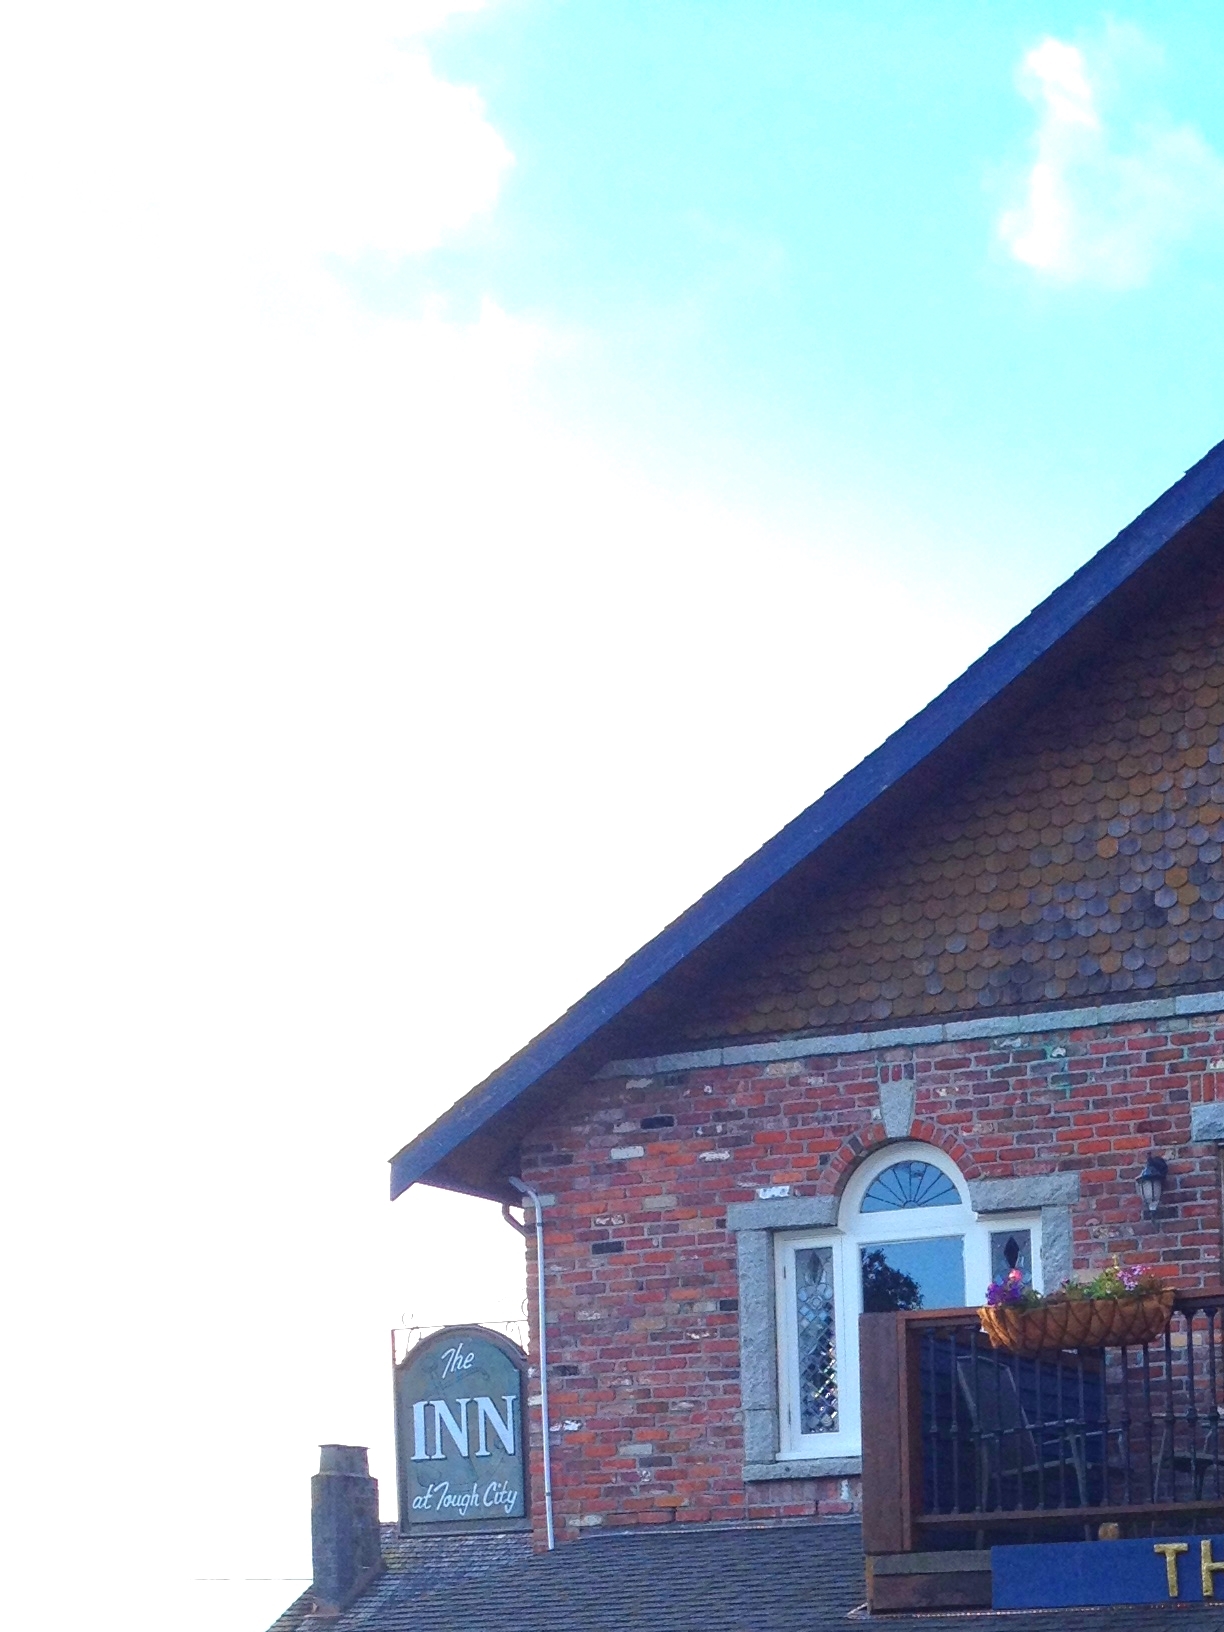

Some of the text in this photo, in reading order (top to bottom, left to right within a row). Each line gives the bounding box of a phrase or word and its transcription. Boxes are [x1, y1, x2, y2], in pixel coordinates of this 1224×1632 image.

[441, 1342, 475, 1379] The
[410, 1395, 517, 1461] INN
[413, 1480, 518, 1516] at Tough City
